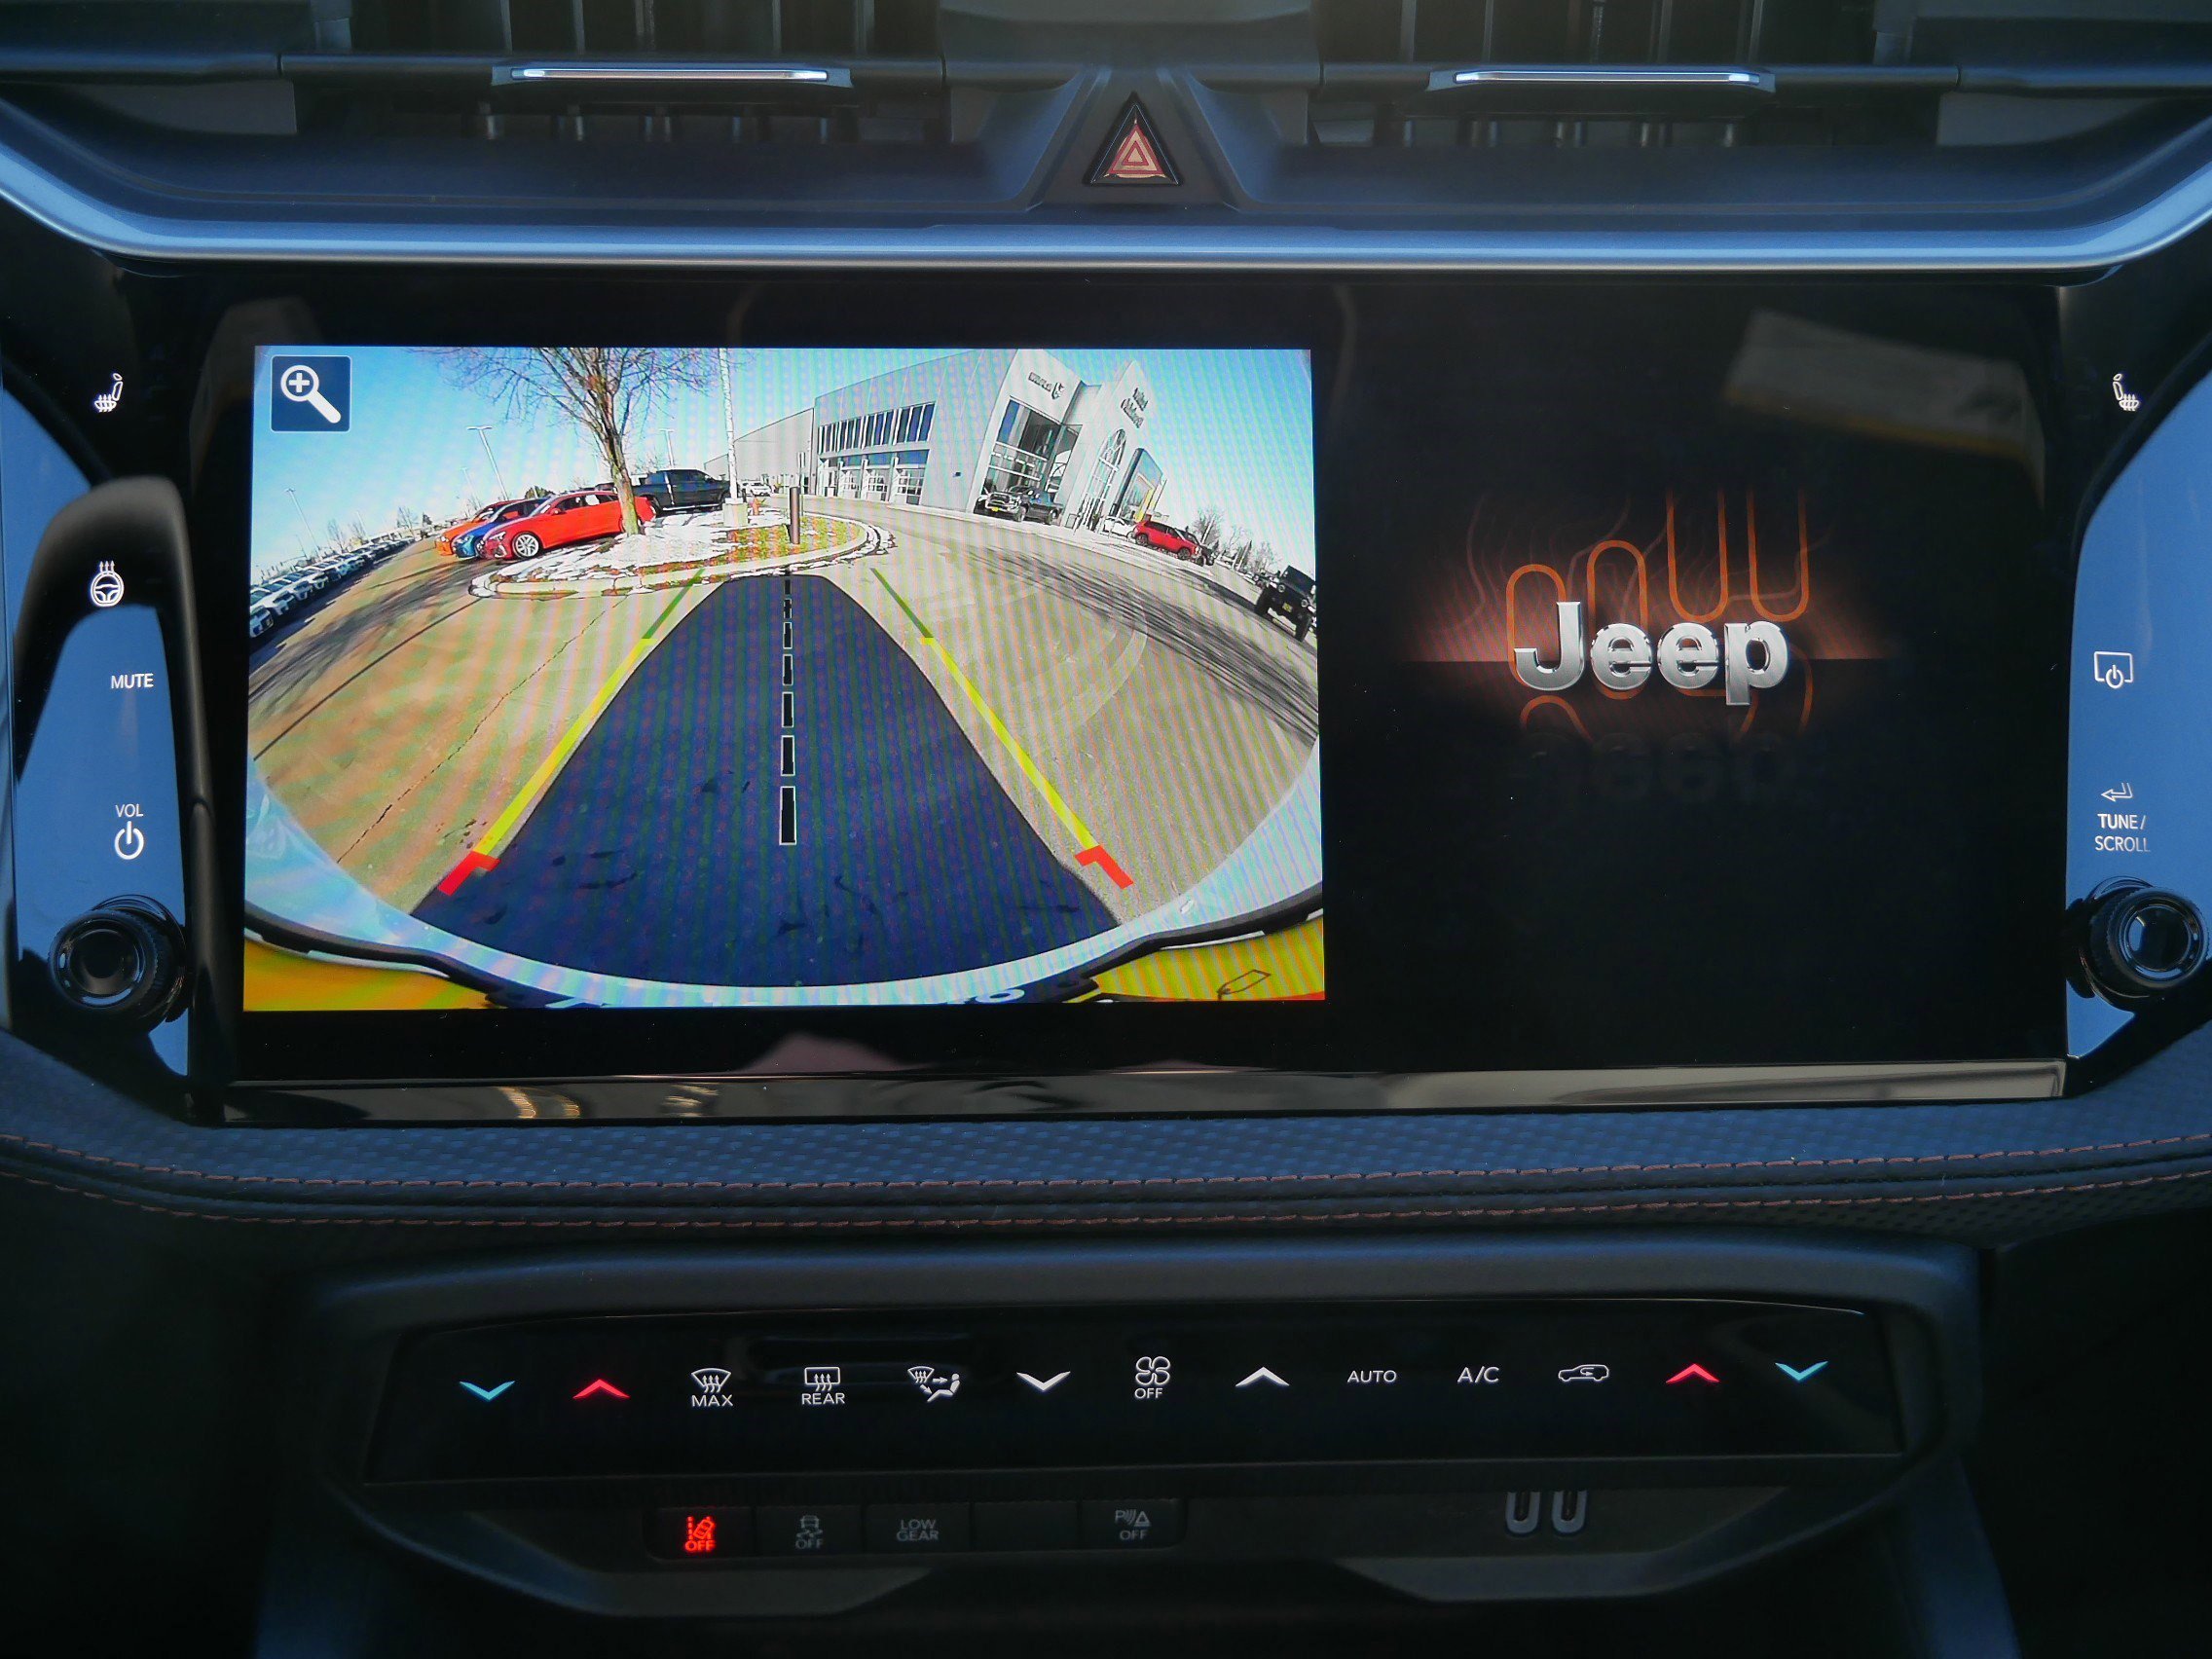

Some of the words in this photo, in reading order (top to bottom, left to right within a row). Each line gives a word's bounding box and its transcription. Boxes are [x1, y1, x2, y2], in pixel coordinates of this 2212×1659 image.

[1514, 601, 1789, 706] Jeep
[110, 672, 155, 689] MUTE
[114, 802, 145, 818] VOL
[2096, 813, 2147, 830] TUNE/
[2094, 834, 2151, 852] SCROLL
[1346, 1369, 1398, 1383] AUTO
[1456, 1365, 1500, 1383] A/C
[800, 1392, 846, 1405] REAR
[1133, 1387, 1163, 1399] OFF
[691, 1394, 734, 1407] MAX
[900, 1518, 937, 1530] LOW
[896, 1530, 940, 1542] GEAR
[1120, 1530, 1148, 1541] OFF
[684, 1539, 717, 1553] OFF
[794, 1538, 824, 1550] OFF
